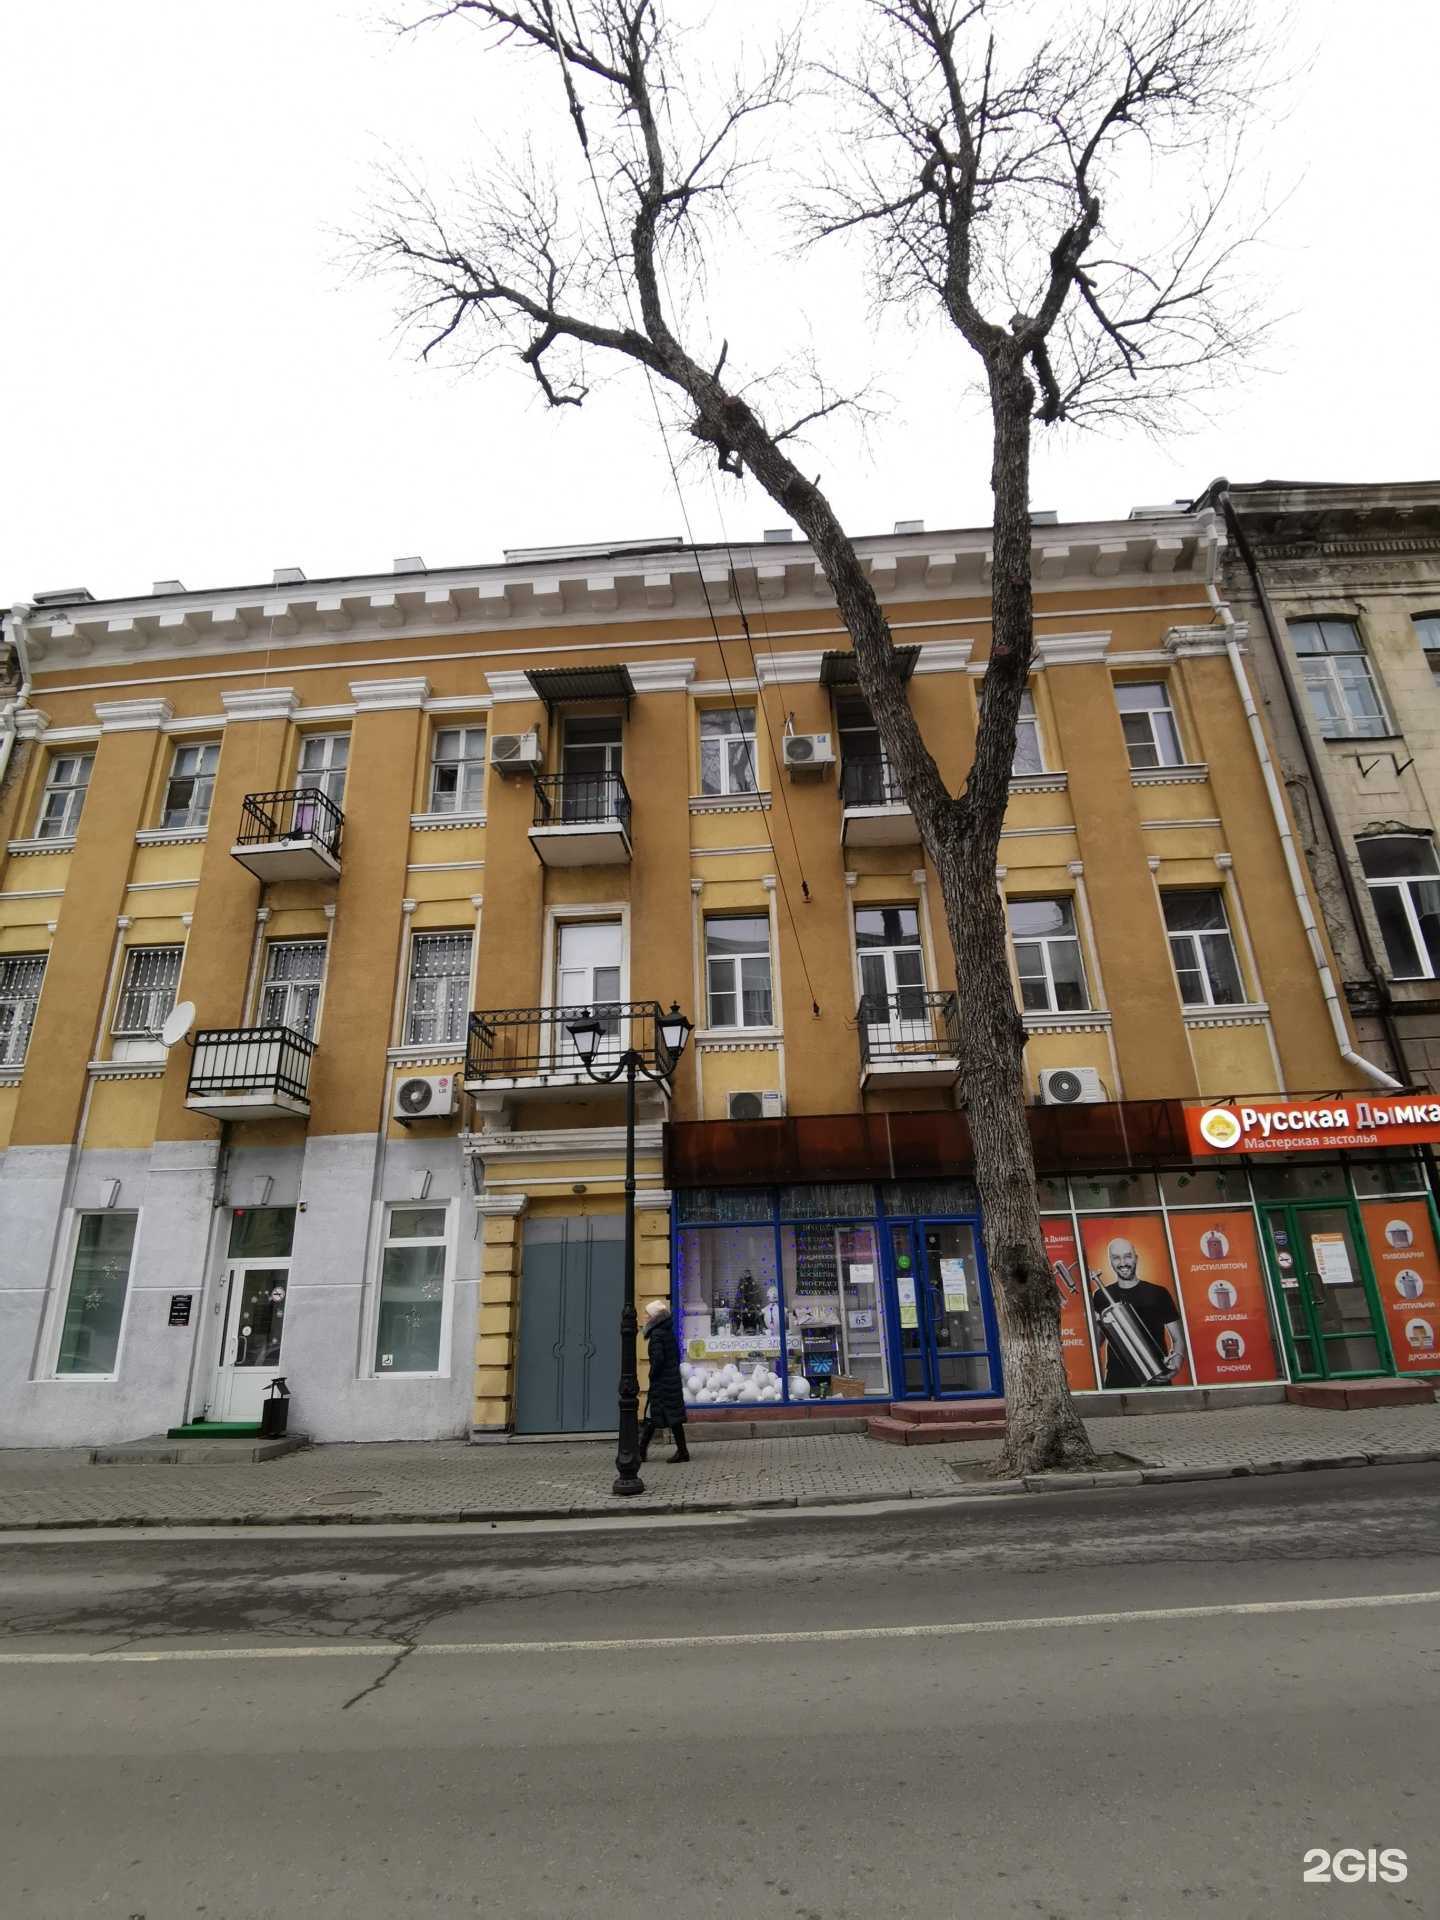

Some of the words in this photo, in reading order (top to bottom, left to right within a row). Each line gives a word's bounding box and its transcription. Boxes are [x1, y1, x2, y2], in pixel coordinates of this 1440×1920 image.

[1240, 1108, 1350, 1137] Русская
[1355, 1103, 1440, 1129] Дымка
[1244, 1137, 1320, 1150] Мастерская
[1322, 1134, 1378, 1145] застолья
[1190, 1262, 1248, 1273] ДИСТИЛЛЯТОРЫ
[1204, 1313, 1248, 1321] АВТОКЛАВЫ
